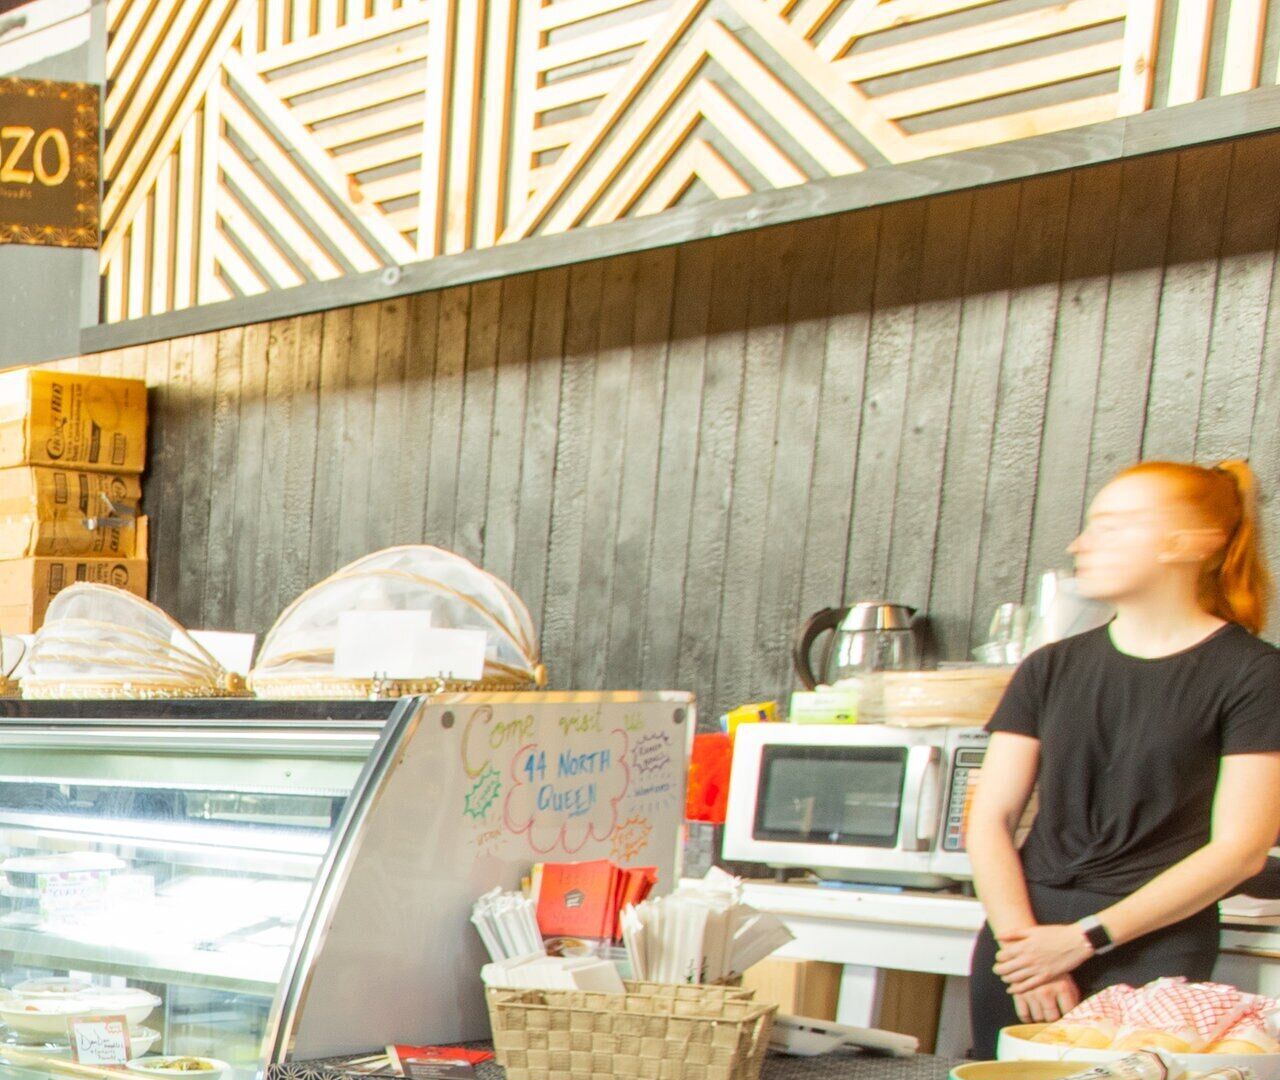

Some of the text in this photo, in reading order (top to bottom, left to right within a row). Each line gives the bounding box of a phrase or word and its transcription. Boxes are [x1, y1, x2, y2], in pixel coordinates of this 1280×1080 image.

[461, 704, 535, 779] Come
[525, 748, 611, 782] 44 NORTH
[537, 783, 596, 811] QUEEN
